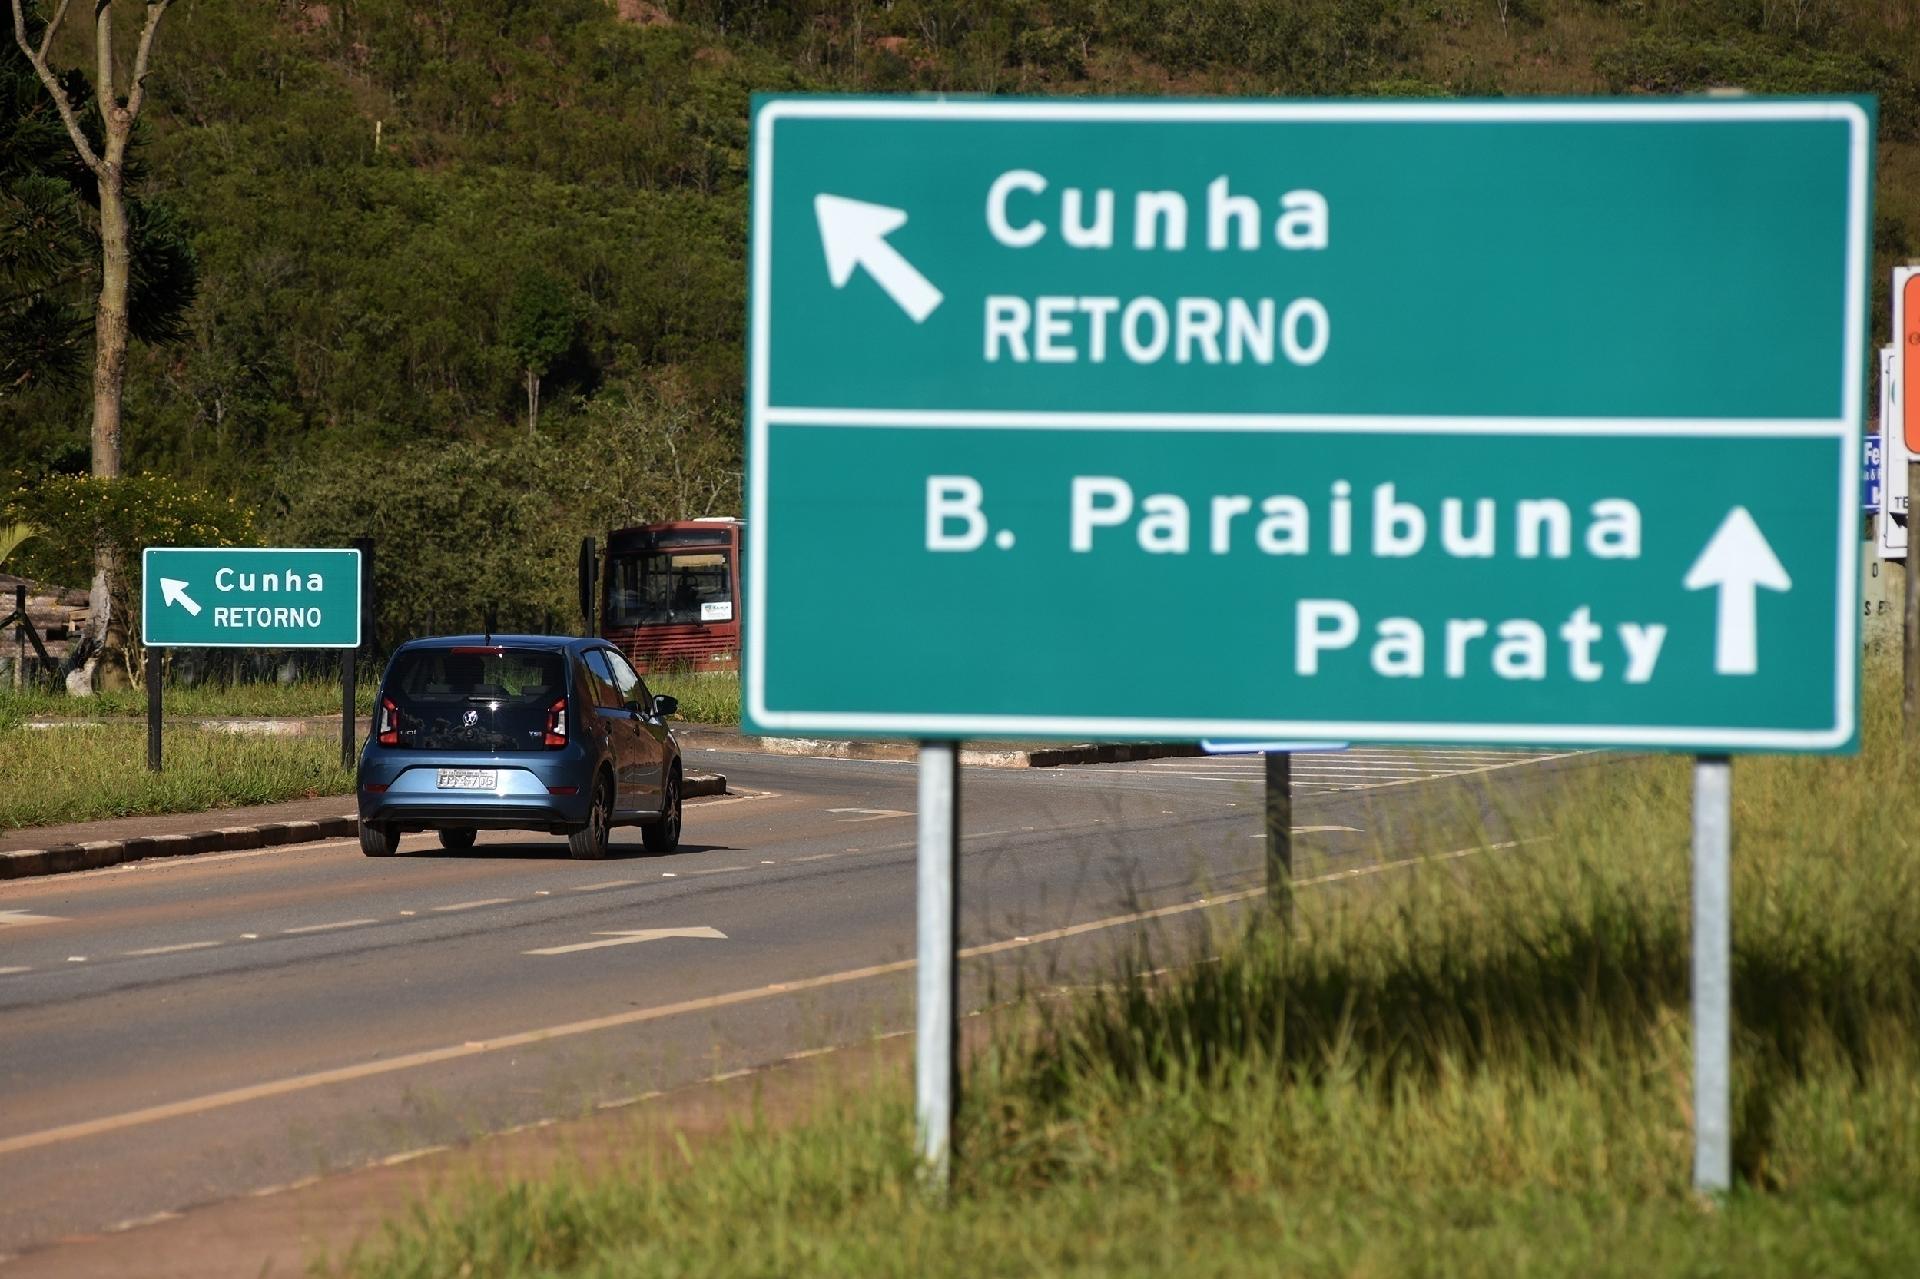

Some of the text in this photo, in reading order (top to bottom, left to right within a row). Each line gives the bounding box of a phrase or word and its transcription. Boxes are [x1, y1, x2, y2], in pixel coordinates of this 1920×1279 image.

[985, 169, 1330, 250] Cunha
[984, 295, 1330, 366] RETORNO
[925, 474, 1642, 560] B. Paraibuna
[213, 607, 322, 628] RETORNO
[214, 567, 324, 593] Cunha
[1295, 598, 1667, 684] Paraty
